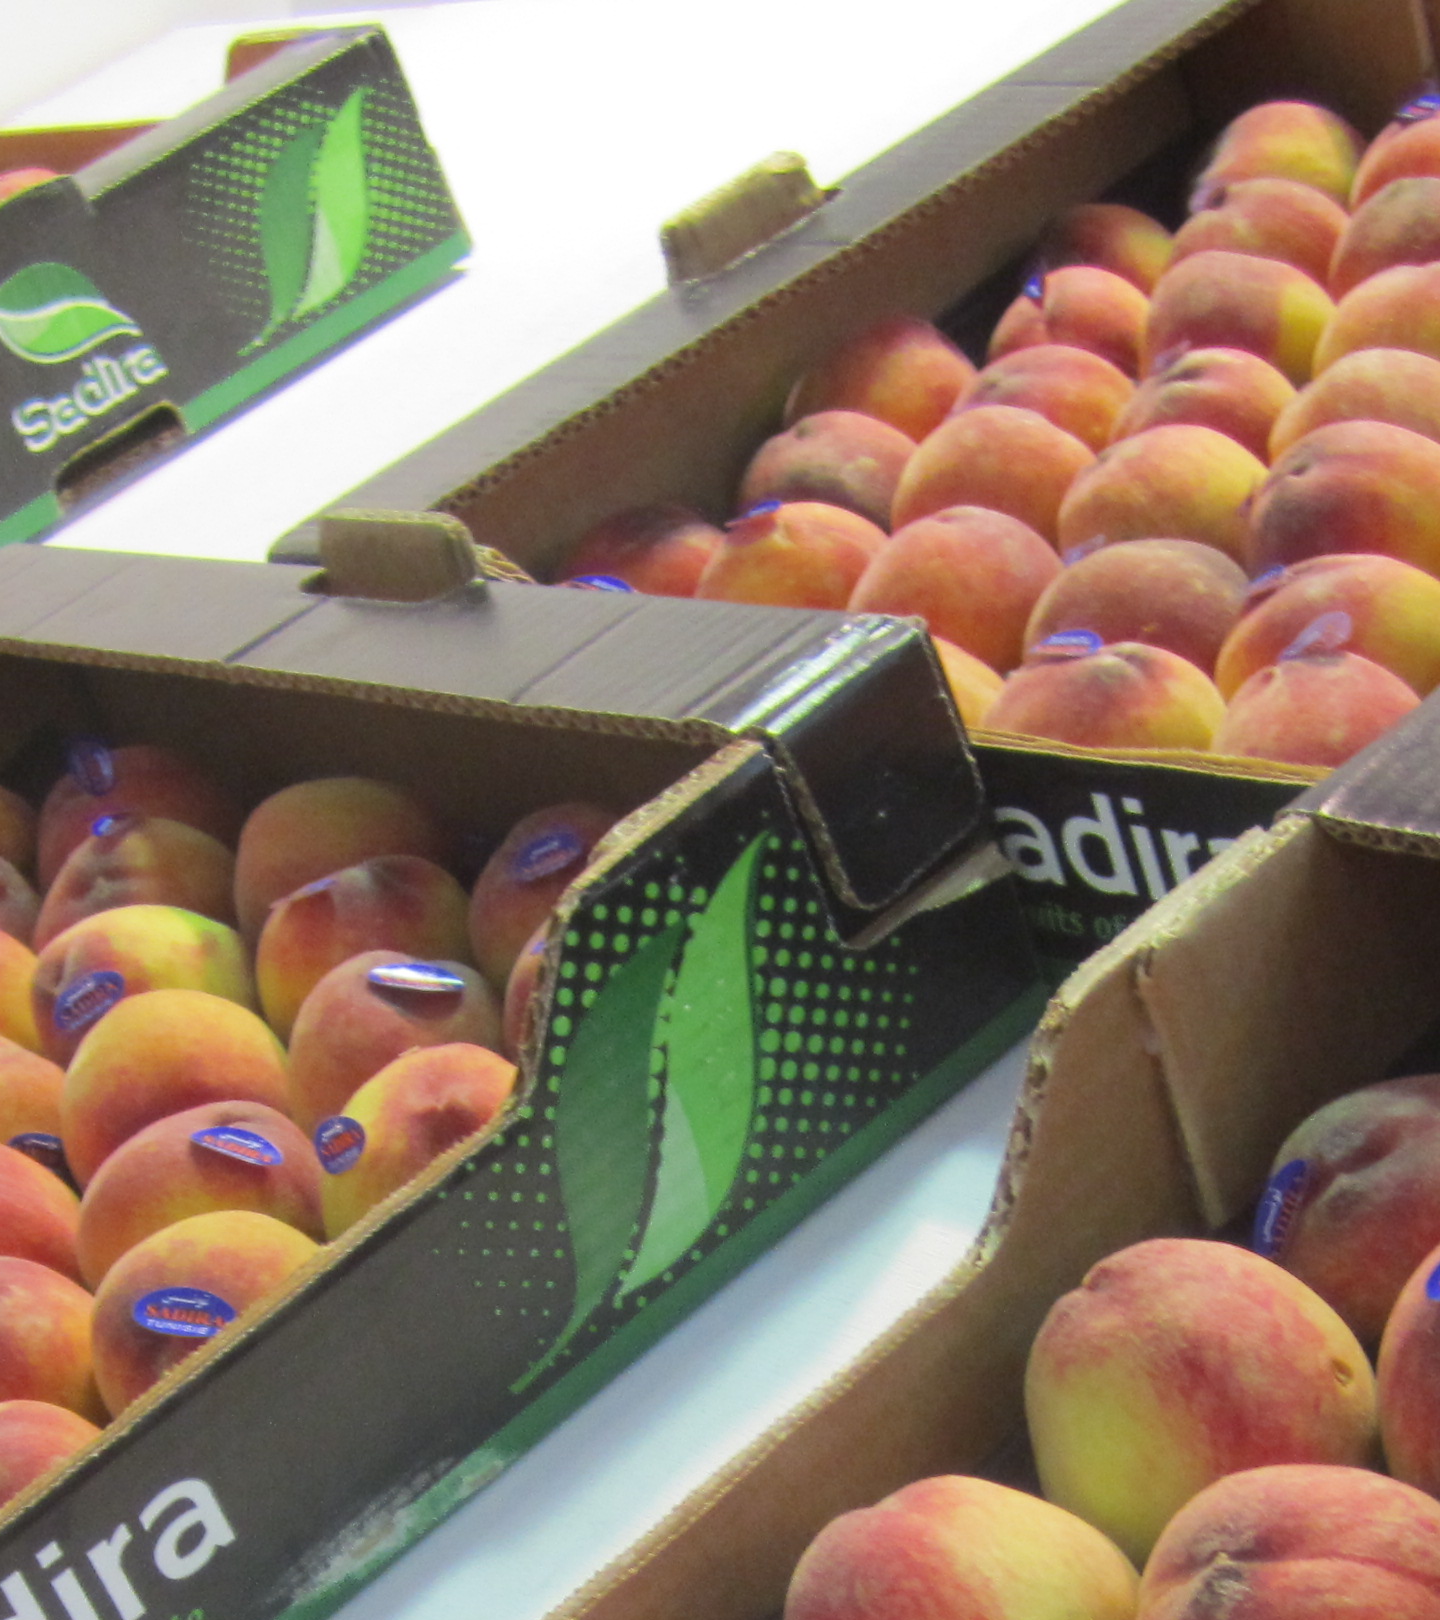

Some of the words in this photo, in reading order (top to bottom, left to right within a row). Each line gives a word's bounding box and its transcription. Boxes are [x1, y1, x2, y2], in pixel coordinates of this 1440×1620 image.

[11, 343, 169, 453] Sadira
[994, 792, 1237, 900] adir
[146, 1304, 226, 1328] SADIRA
